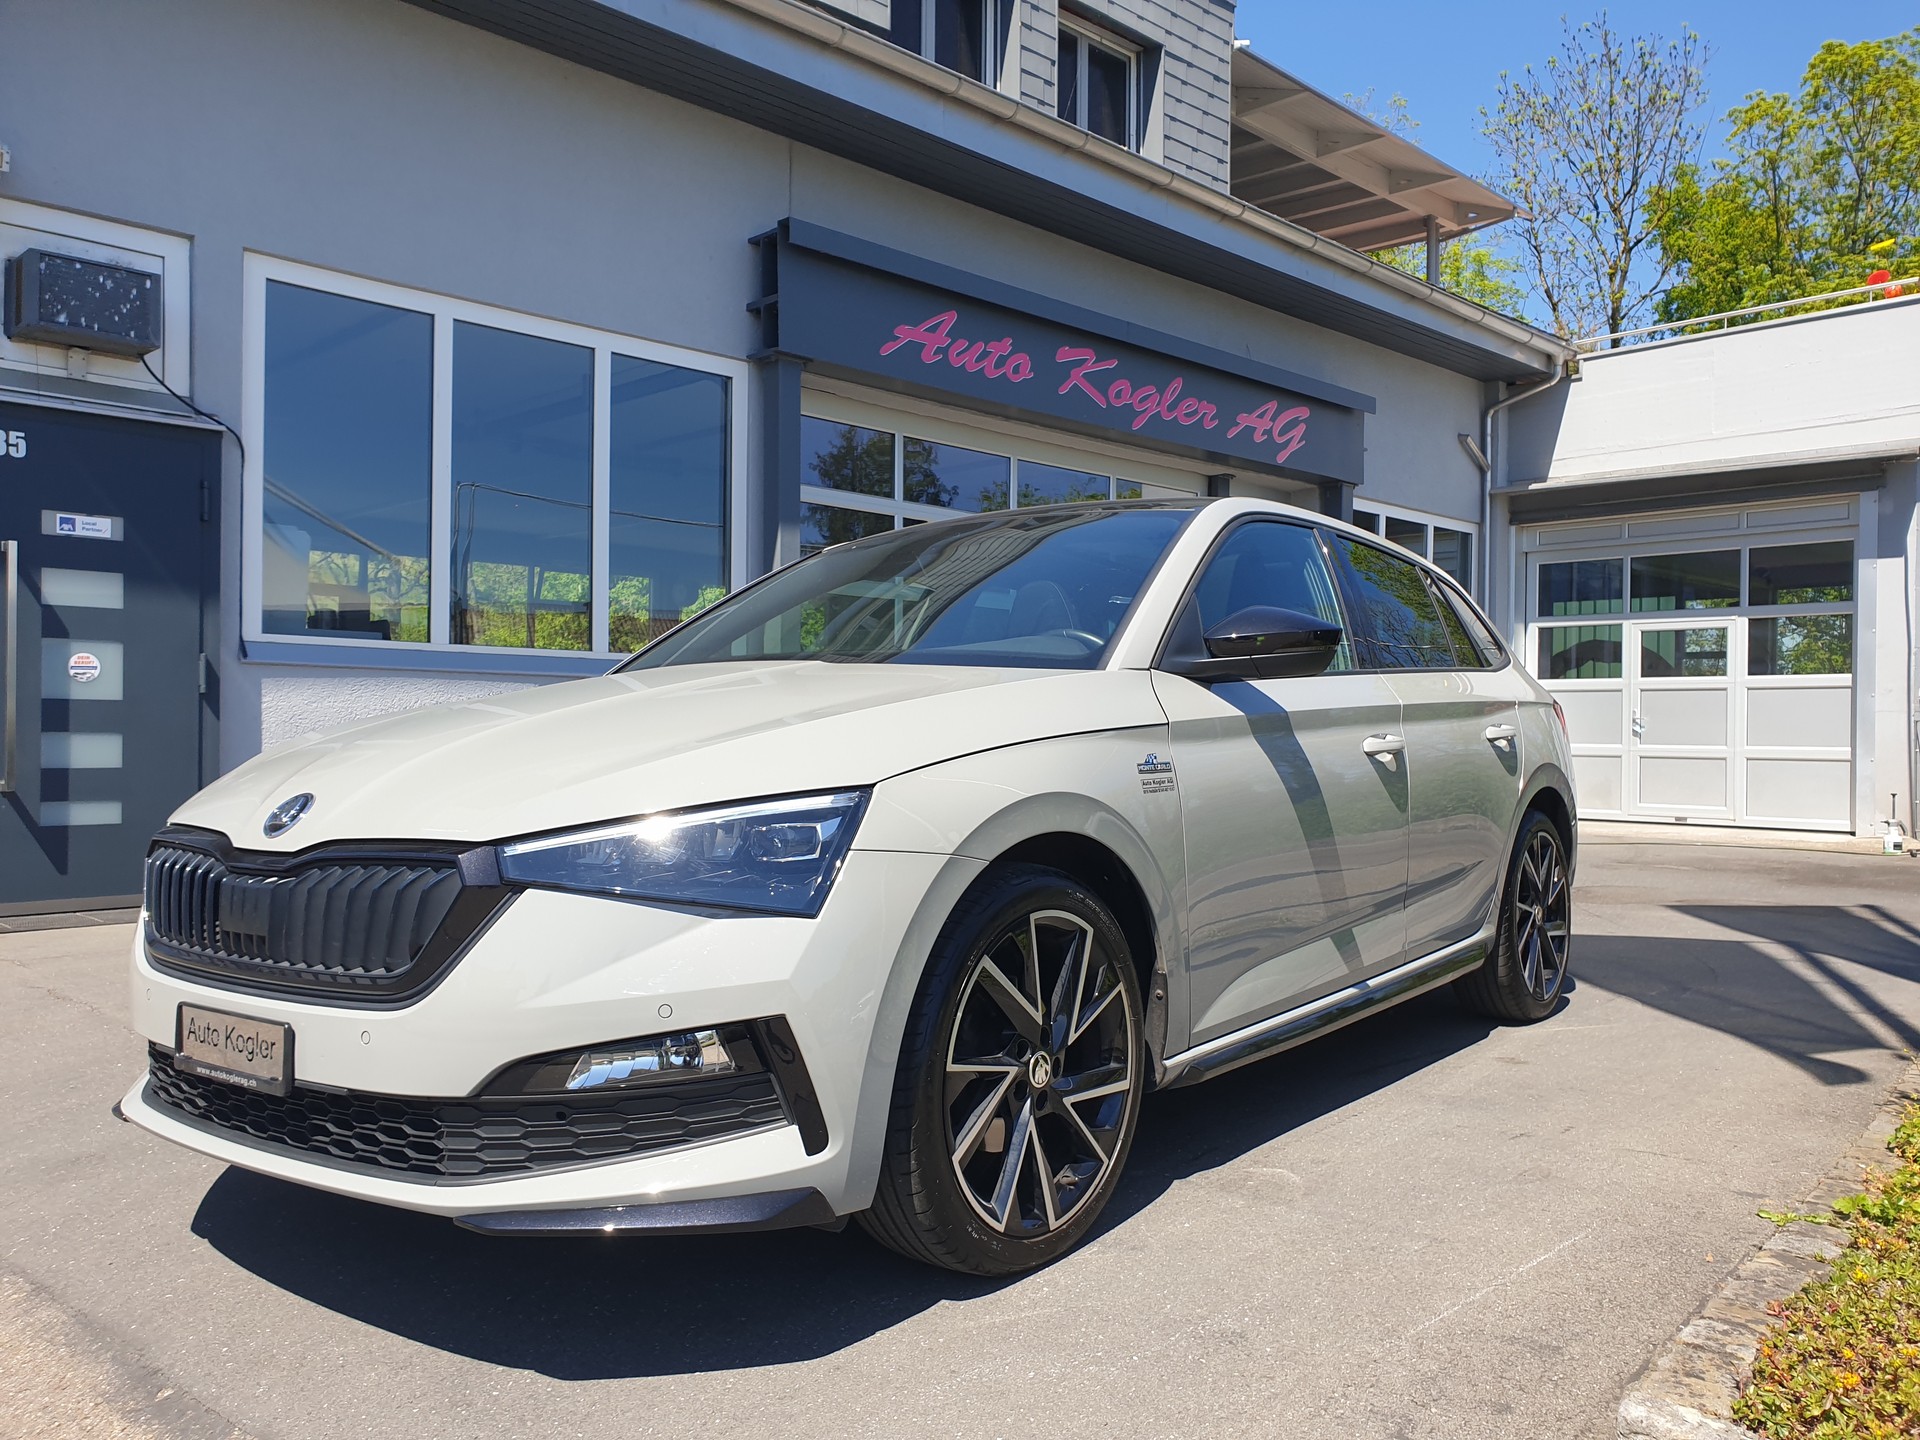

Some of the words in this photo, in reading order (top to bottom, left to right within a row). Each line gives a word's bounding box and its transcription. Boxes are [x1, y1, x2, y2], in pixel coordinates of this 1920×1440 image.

[879, 310, 1034, 382] Auto
[1055, 346, 1219, 431] Kogler
[1226, 400, 1310, 463] AG
[187, 1017, 220, 1047] Auto
[225, 1025, 276, 1062] Kogler
[196, 1066, 257, 1087] www.autokoglerag.ch
